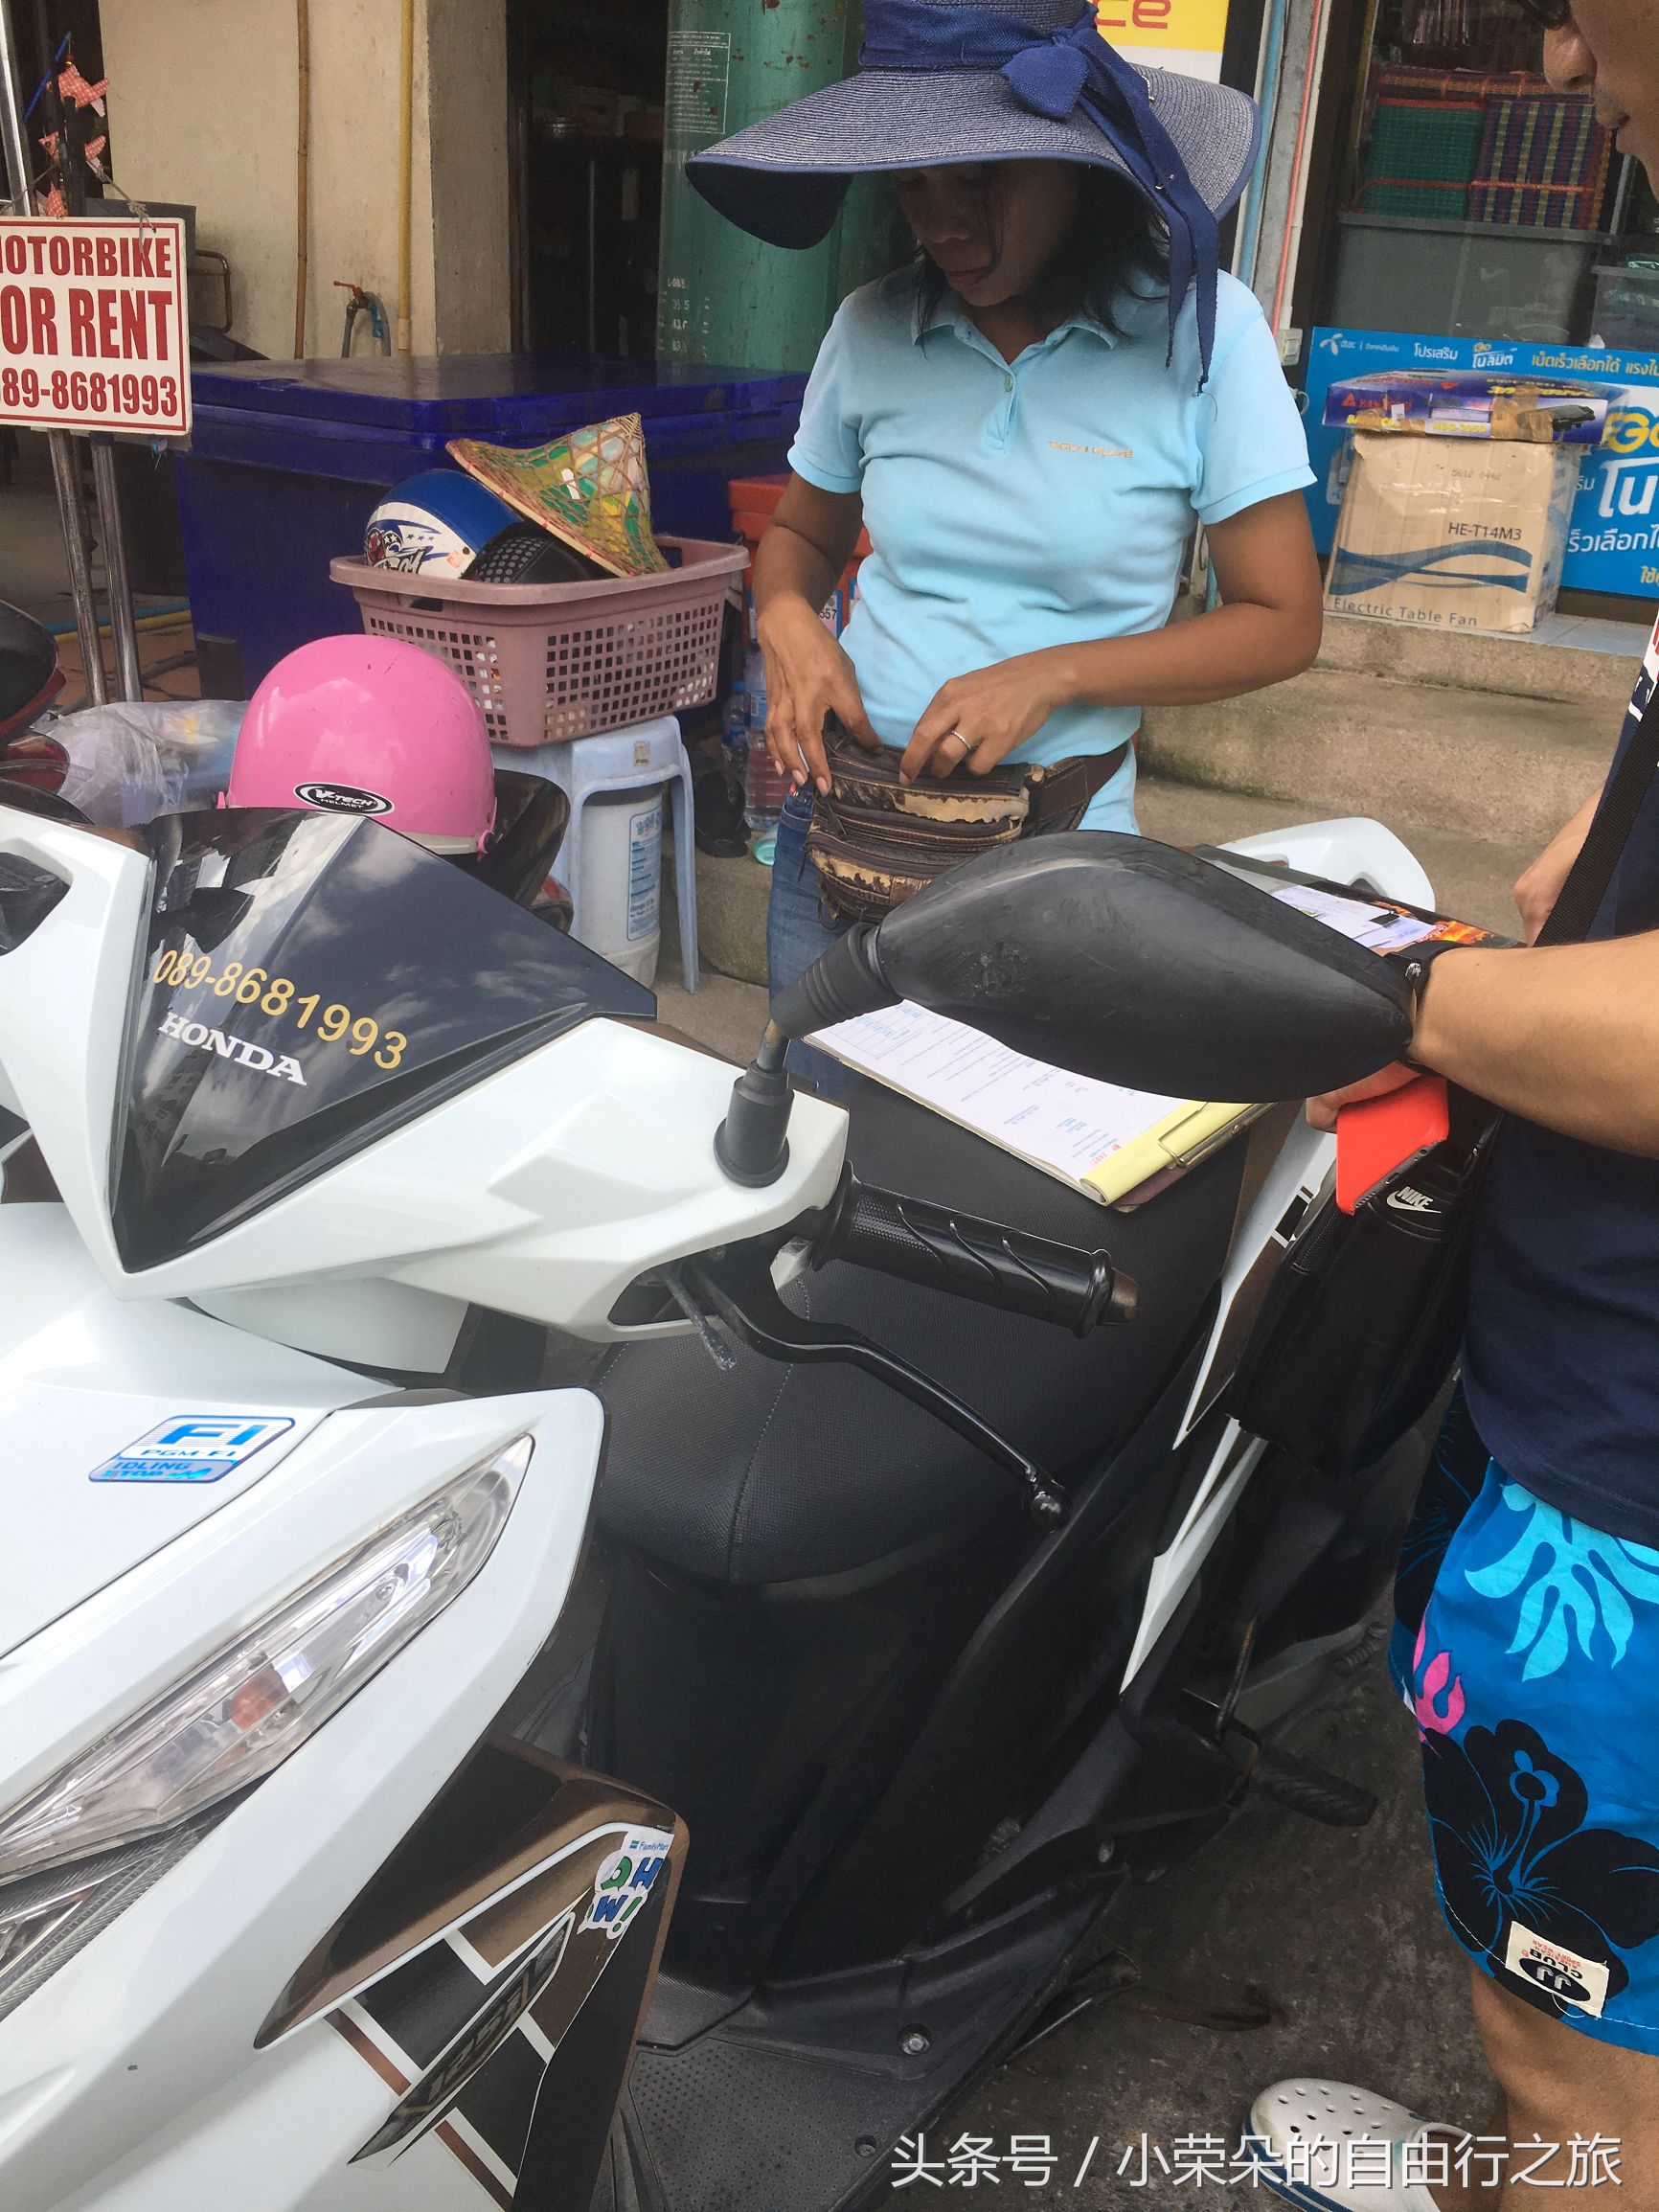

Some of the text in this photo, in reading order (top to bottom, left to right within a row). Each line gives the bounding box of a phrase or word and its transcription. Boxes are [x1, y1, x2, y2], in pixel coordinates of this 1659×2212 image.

[0, 235, 172, 278] OTORBIKE
[69, 288, 172, 361] RENT
[1413, 342, 1459, 360] โปรเสริม
[0, 367, 178, 417] 89-8681993
[1607, 412, 1659, 454] G
[1447, 521, 1522, 540] HE-T14M3
[1568, 523, 1659, 553] ร็วเลือกไ
[1333, 597, 1478, 627] Electric Table Fan
[320, 798, 364, 809] HELMET
[152, 949, 408, 1070] 089-8681993
[158, 1012, 308, 1086] HONDA
[1396, 1186, 1434, 1207] NIKE
[156, 1424, 268, 1446] FI
[102, 1470, 165, 1479] STOP
[639, 1841, 670, 1851] FamilyMart
[1530, 1948, 1583, 1980] CLUB
